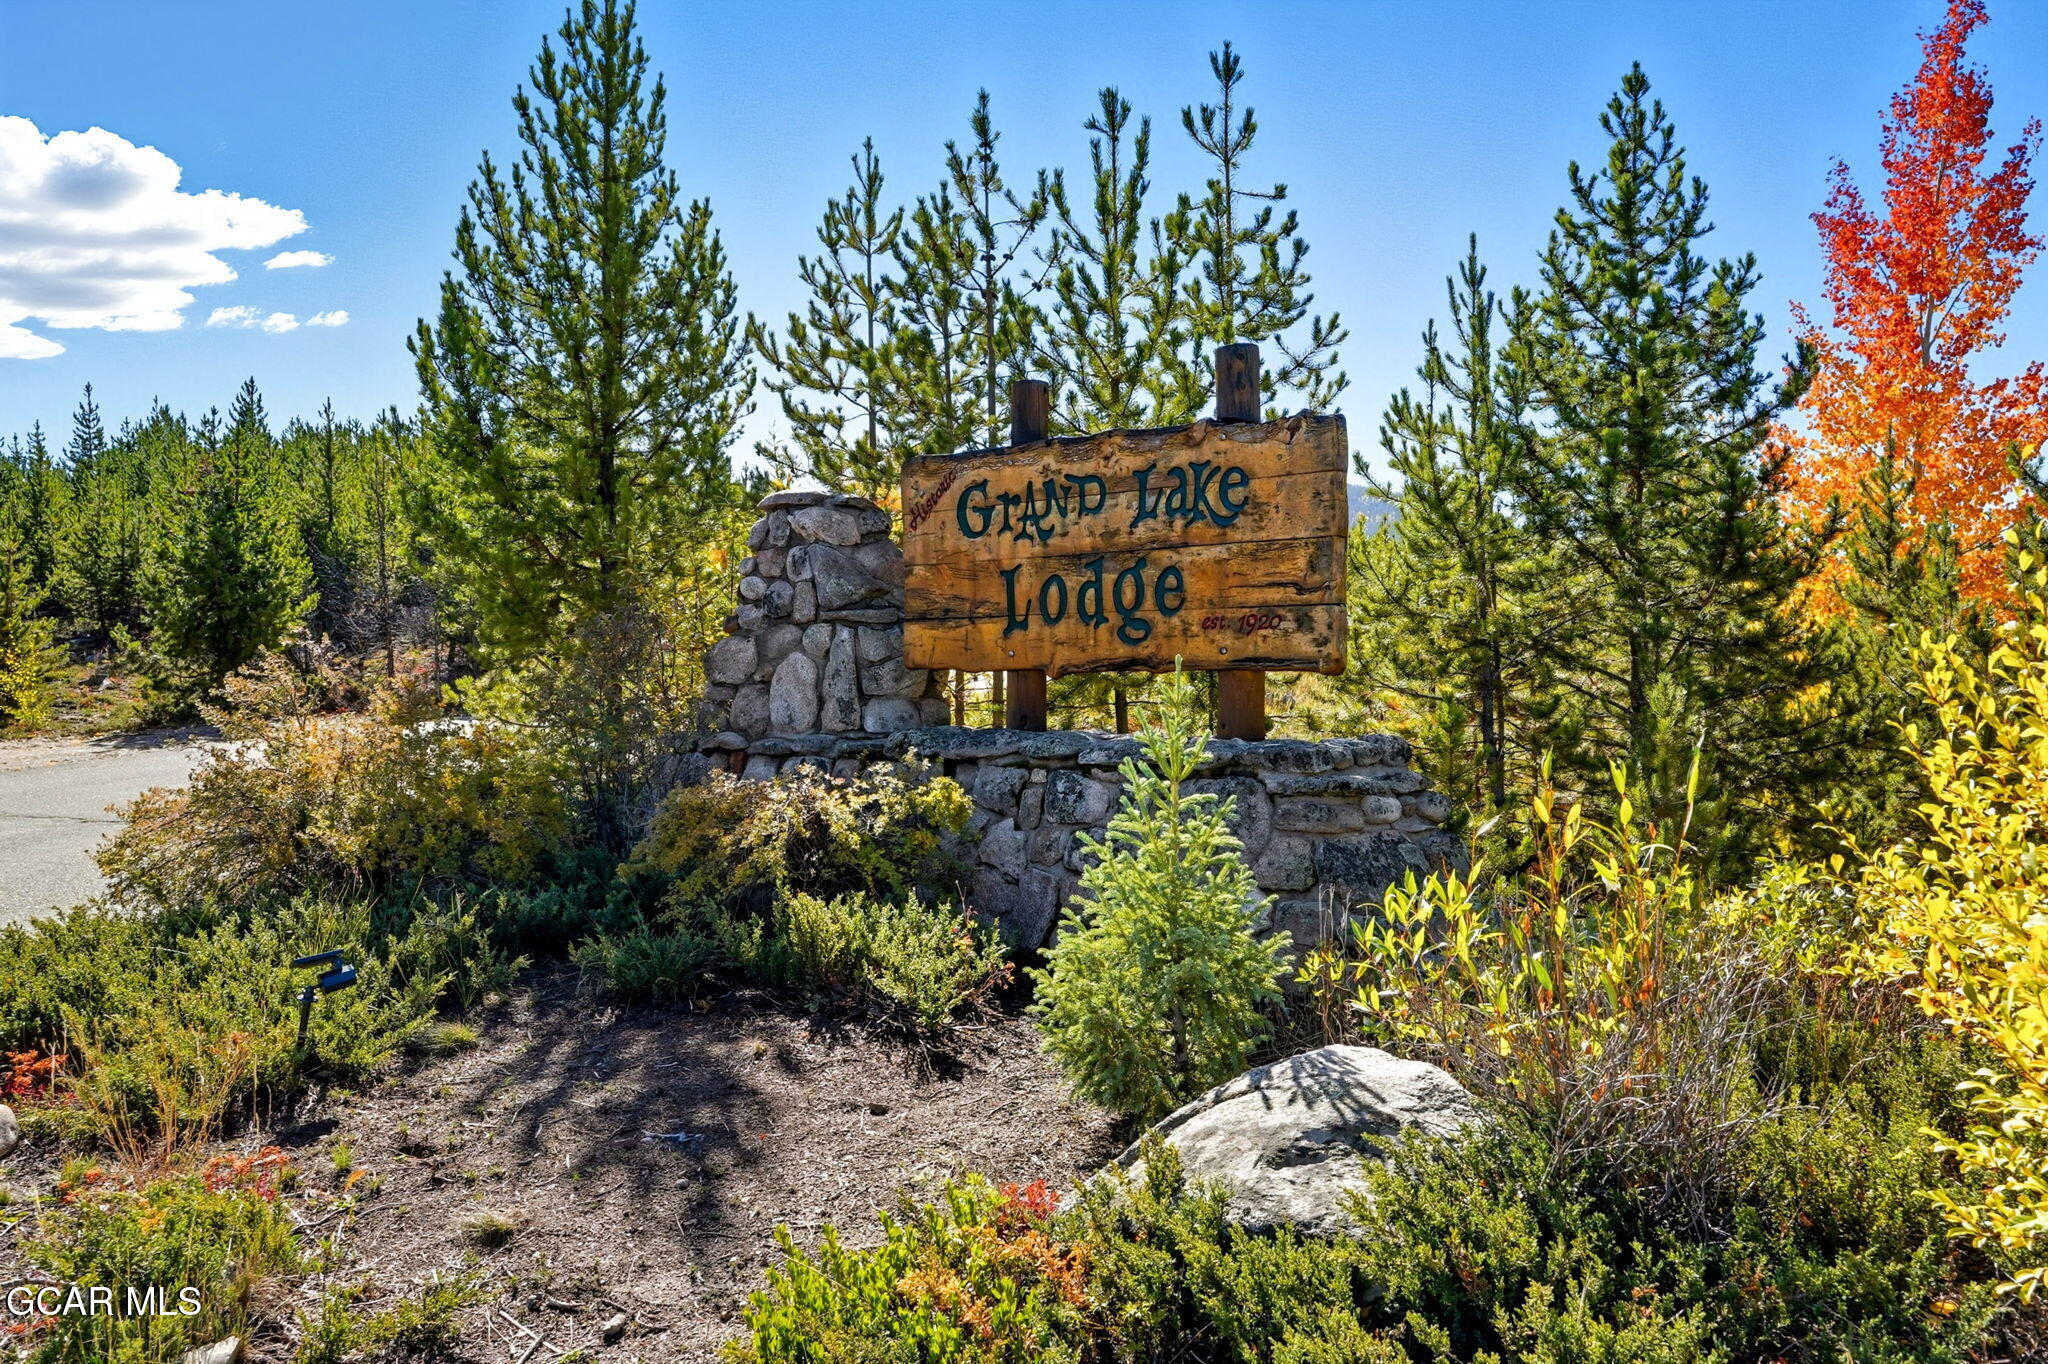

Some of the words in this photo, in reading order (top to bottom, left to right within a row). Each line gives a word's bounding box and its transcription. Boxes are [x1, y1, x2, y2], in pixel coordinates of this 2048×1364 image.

[909, 469, 957, 533] Historic
[1000, 555, 1186, 647] Lodge
[1201, 615, 1231, 630] est.
[1237, 613, 1283, 637] 1920
